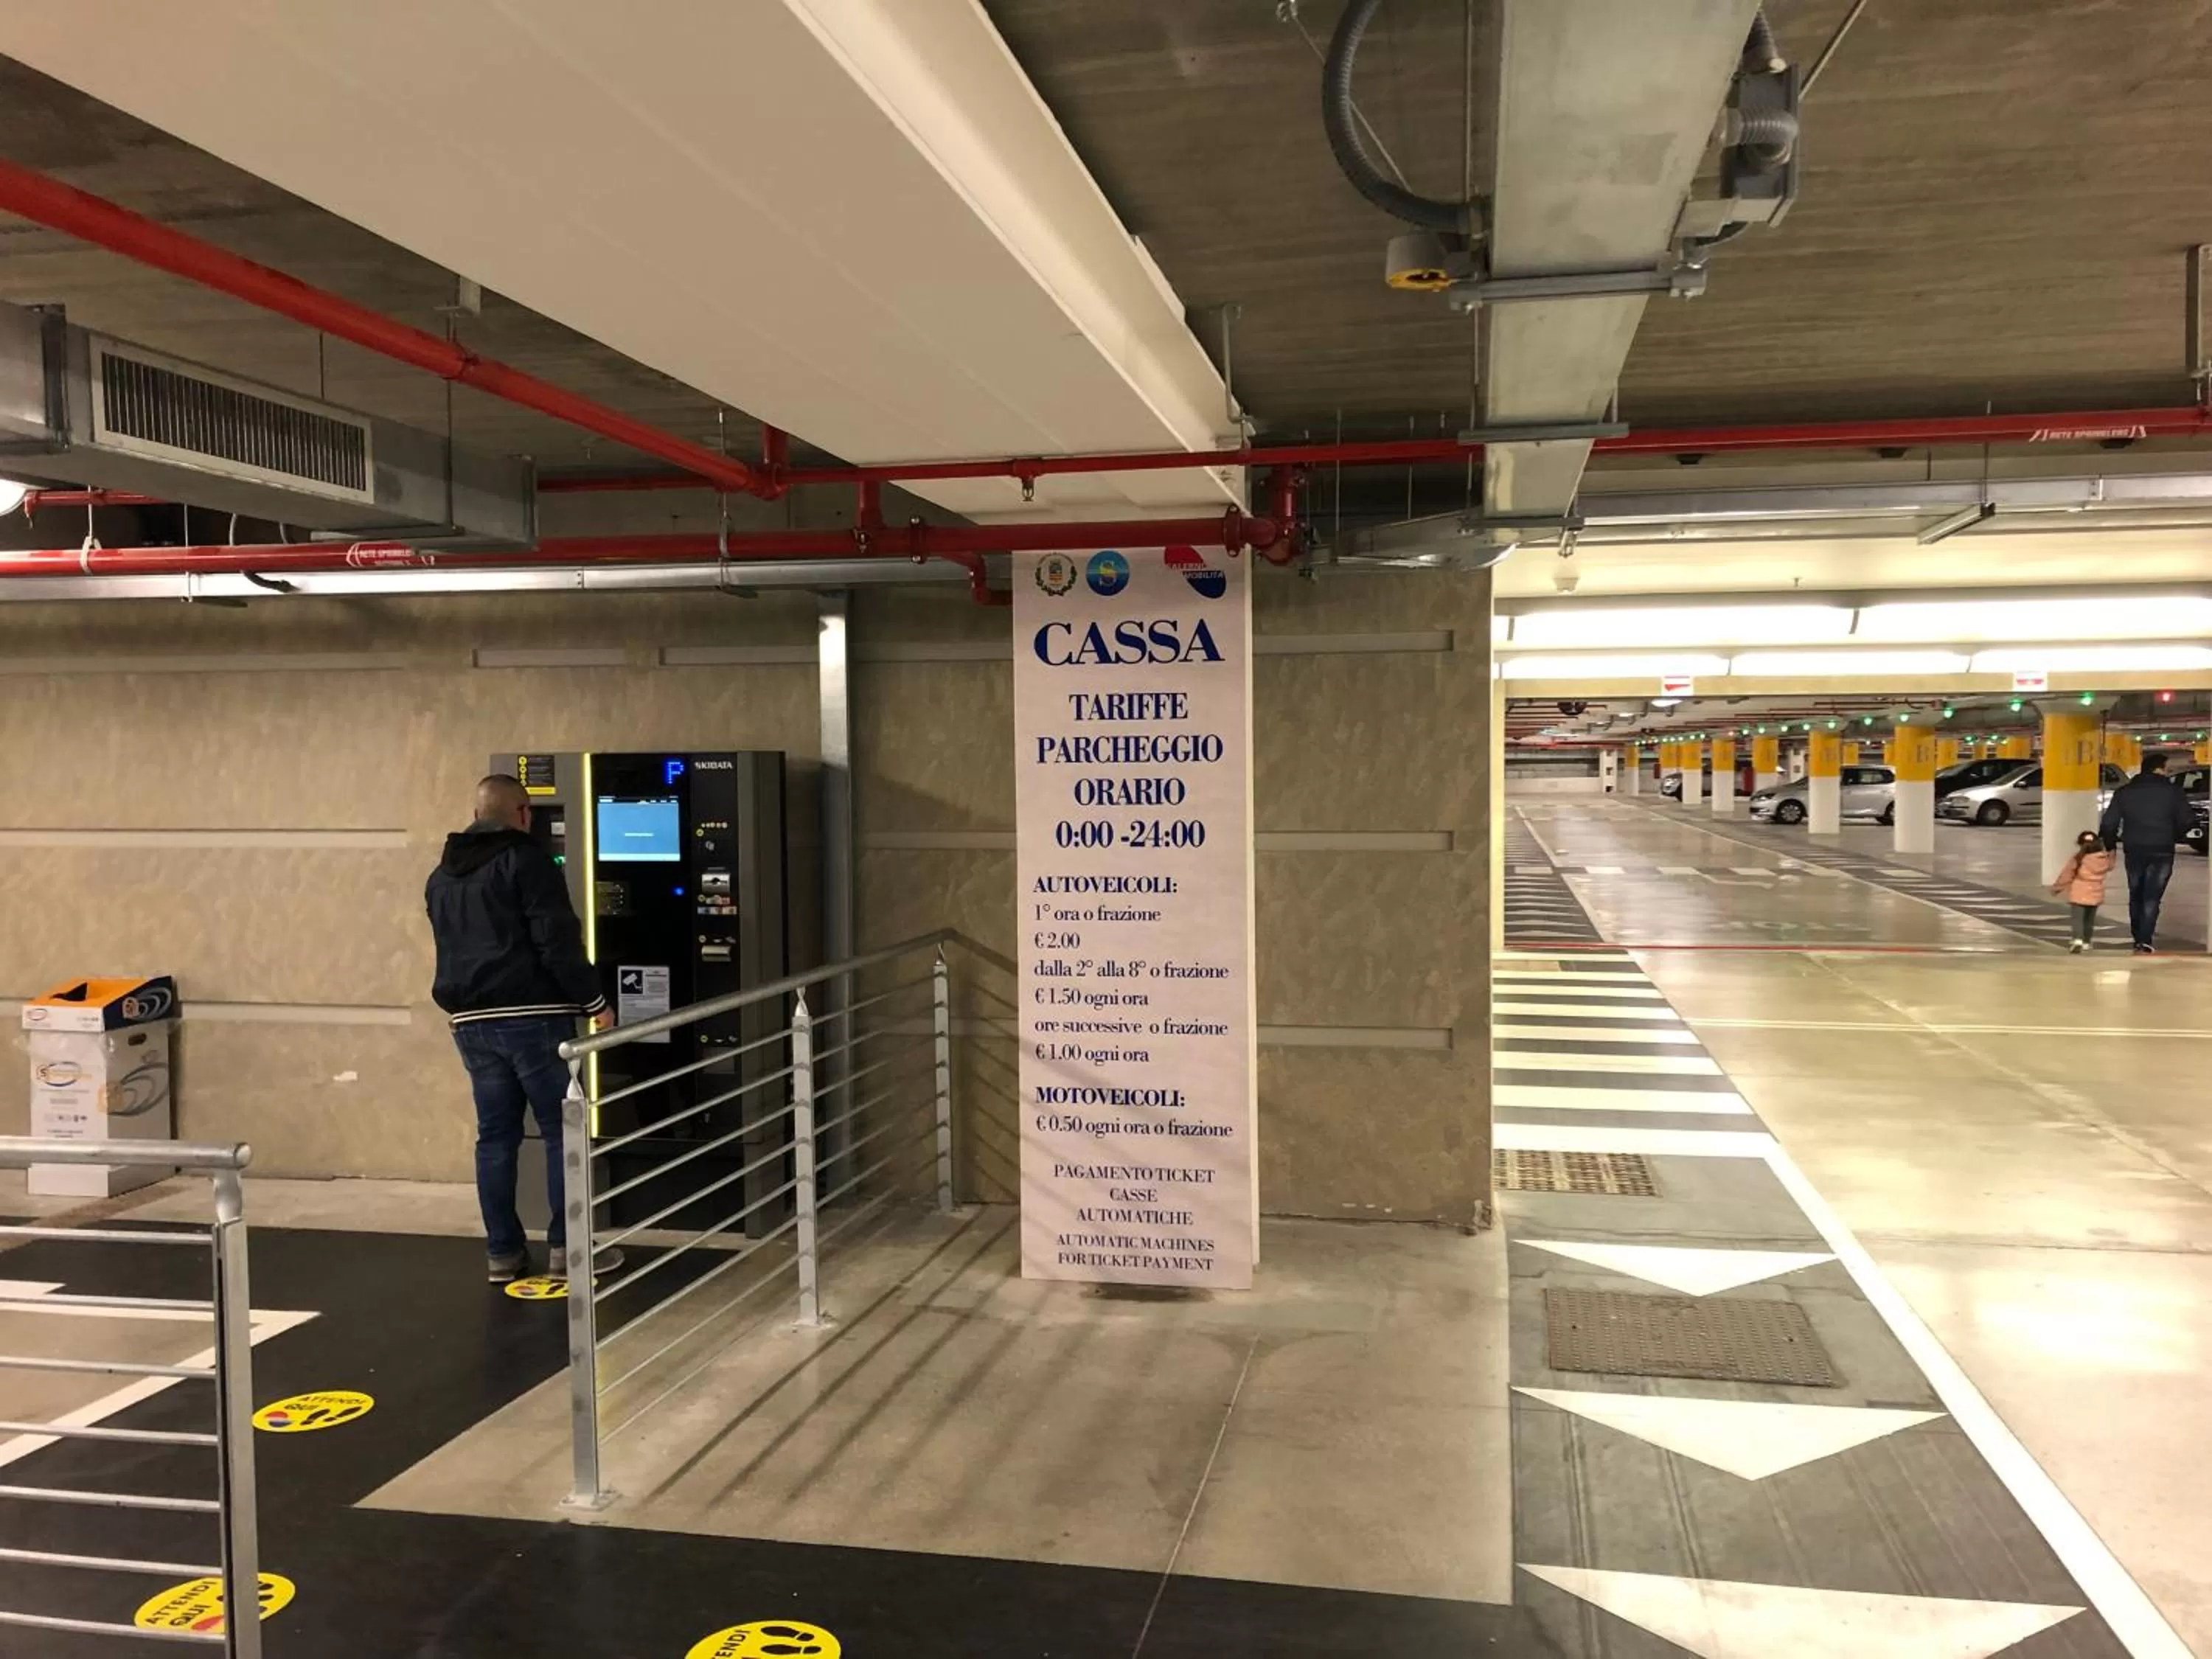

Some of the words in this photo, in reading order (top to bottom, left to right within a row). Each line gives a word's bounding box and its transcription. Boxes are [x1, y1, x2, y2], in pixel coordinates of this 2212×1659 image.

[1034, 619, 1225, 666] CASSA
[1068, 692, 1188, 721] TARIFFE
[1036, 734, 1224, 764] PARCHEGGIO
[694, 760, 734, 770] SKIDATA
[1074, 777, 1186, 805] ORARIO
[1056, 820, 1113, 848] 0:00
[1033, 875, 1179, 894] AUTOVEICOLI:
[1054, 909, 1080, 921] ora
[1083, 909, 1093, 921] o
[1097, 905, 1161, 922] frazione
[1034, 932, 1045, 949] €
[1047, 932, 1081, 949] 2.00
[1034, 959, 1072, 978] dalla
[1096, 960, 1125, 978] alla
[1150, 966, 1160, 978] o
[1164, 961, 1231, 979] frazione
[1034, 988, 1046, 1004] €
[1049, 988, 1081, 1005] 1.50
[1084, 989, 1119, 1010] ogni
[1122, 993, 1149, 1006] ora
[1034, 1020, 1060, 1033] ore
[1062, 1017, 1142, 1034] successive
[1149, 1022, 1160, 1034] o
[1164, 1017, 1229, 1036] frazione
[1035, 1043, 1046, 1060] €
[1049, 1043, 1082, 1061] 1.00
[1084, 1045, 1119, 1066] ogni
[1122, 1049, 1150, 1062] ora
[1035, 1086, 1186, 1107] MOTOVEICOLI:
[1036, 1115, 1047, 1132] €
[1049, 1115, 1083, 1133] 0.50
[1085, 1117, 1121, 1139] ogni
[1124, 1122, 1150, 1135] ora
[1154, 1122, 1164, 1135] o
[1168, 1118, 1234, 1138] frazione
[1054, 1164, 1154, 1180] PAGAMENTO
[1155, 1167, 1215, 1183] TICKET
[1109, 1189, 1158, 1203] CASSE
[1077, 1208, 1194, 1226] AUTOMATICHE
[1056, 1234, 1139, 1249] AUTOMATIC
[1141, 1237, 1215, 1252] MACHINES
[1057, 1252, 1087, 1265] FOR
[1090, 1253, 1142, 1268] TICKET
[1143, 1256, 1214, 1272] PAYMENT
[145, 1581, 218, 1624] ATTENDI
[169, 1604, 212, 1626] QUI
